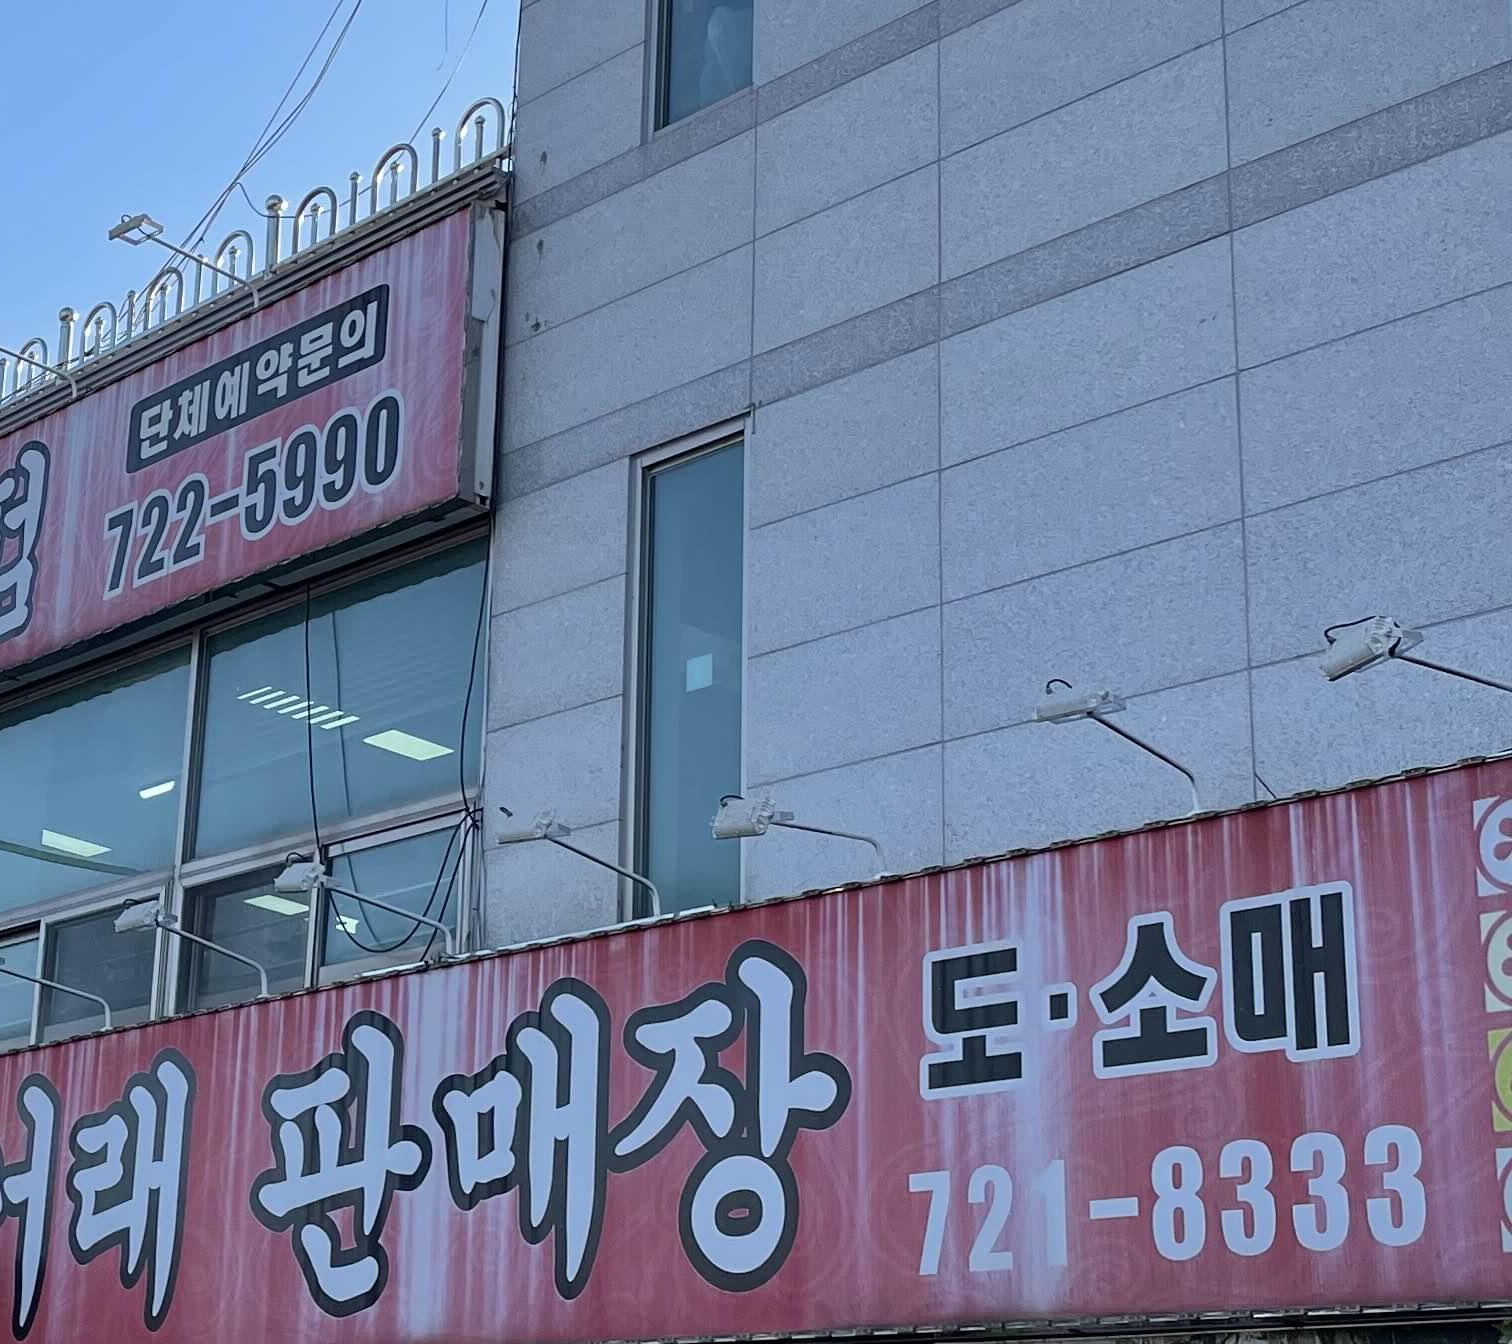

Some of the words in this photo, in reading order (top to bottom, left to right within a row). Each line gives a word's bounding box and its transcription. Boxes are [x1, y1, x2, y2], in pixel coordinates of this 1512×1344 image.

[138, 301, 378, 458] 단체예약문의
[103, 389, 405, 603] 722-5990
[251, 939, 852, 1318] 판매장
[908, 1125, 1427, 1276] 721-8333
